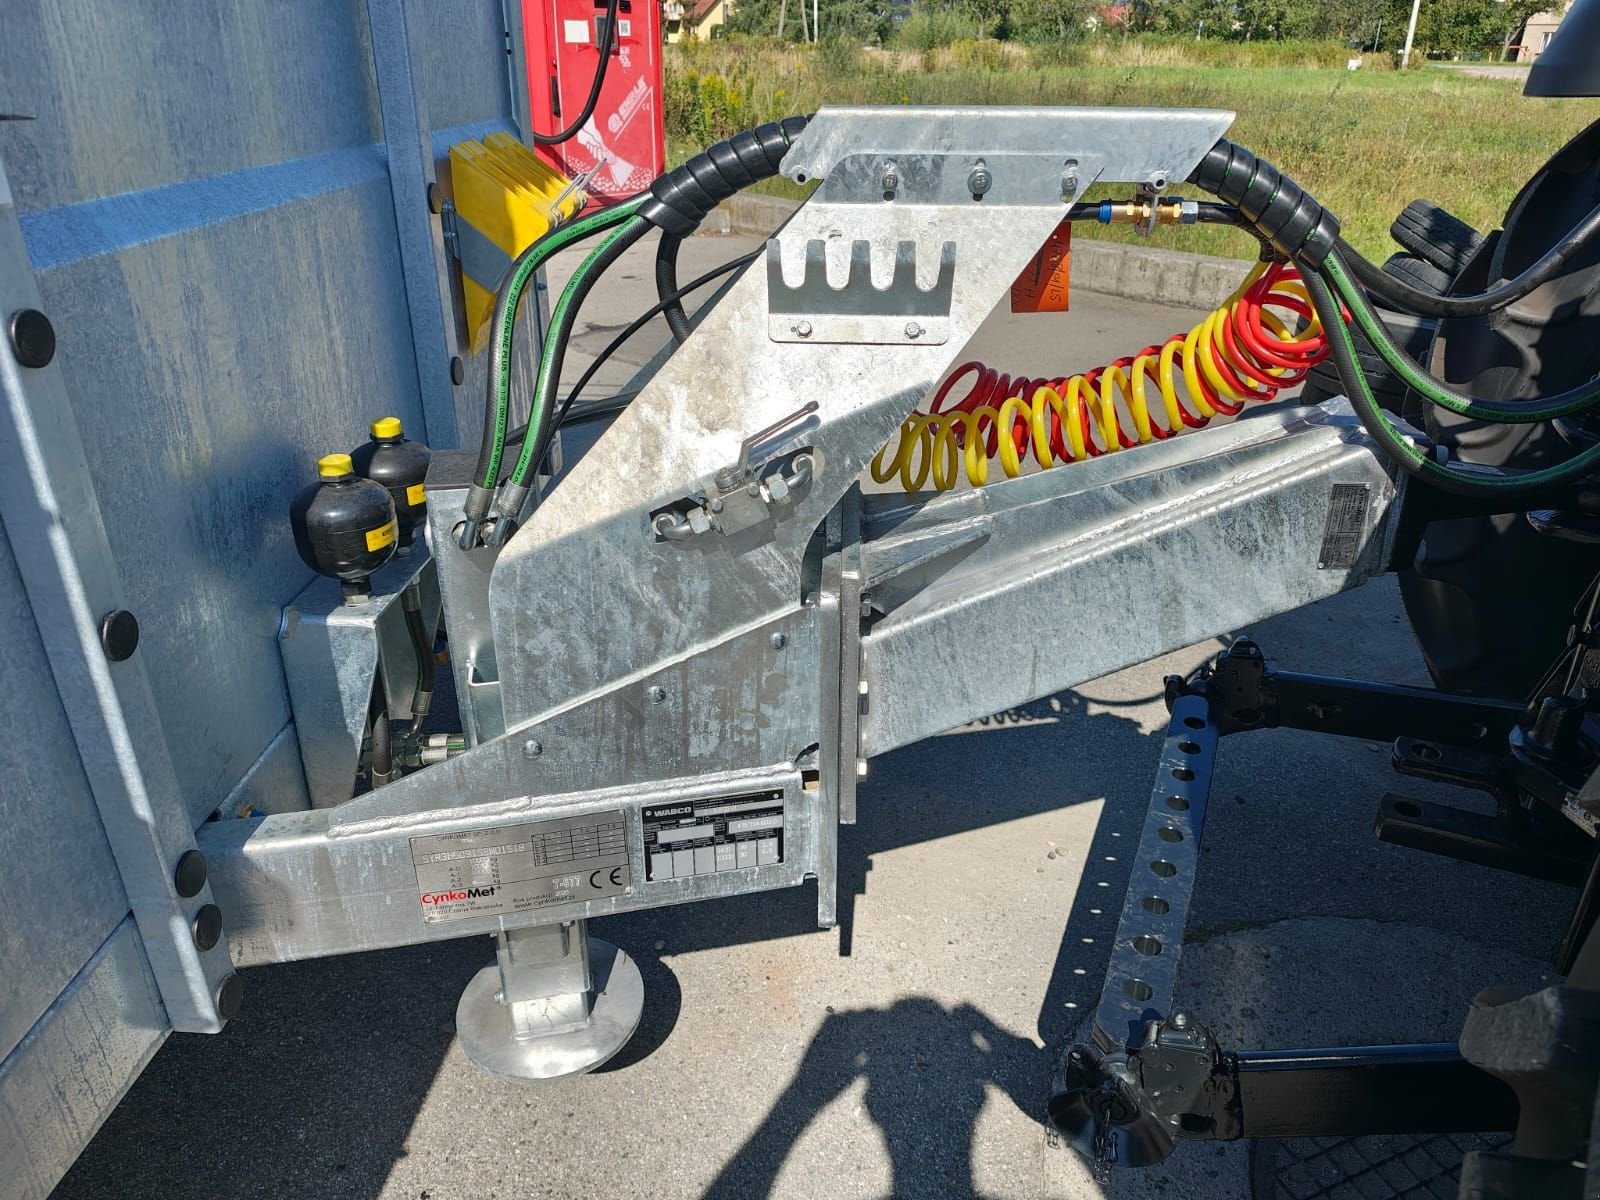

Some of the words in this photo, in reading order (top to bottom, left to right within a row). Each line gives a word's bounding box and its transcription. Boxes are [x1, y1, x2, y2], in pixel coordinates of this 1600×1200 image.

[501, 305, 513, 348] GREENLINE
[494, 436, 502, 452] MAX
[492, 453, 500, 465] WP
[513, 453, 528, 482] DUNLO
[653, 806, 692, 817] WABCO
[421, 886, 496, 905] CynkoMet
